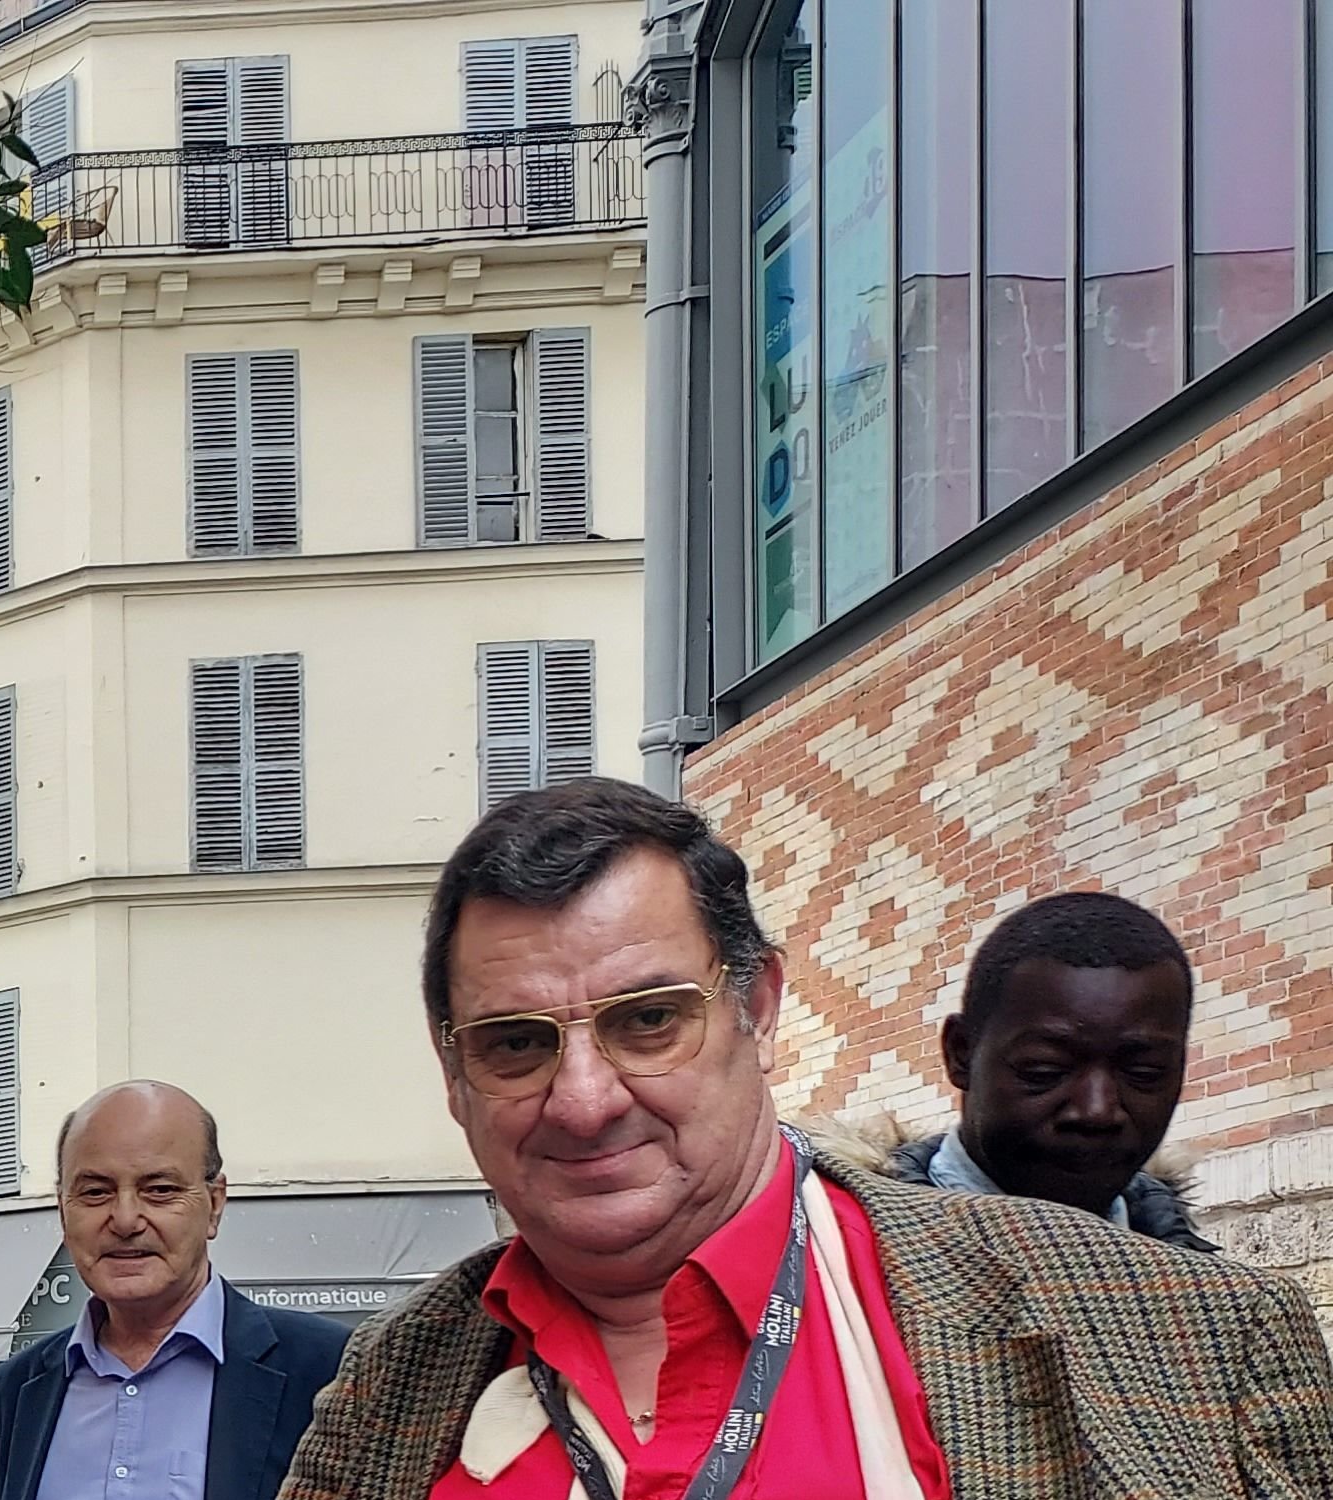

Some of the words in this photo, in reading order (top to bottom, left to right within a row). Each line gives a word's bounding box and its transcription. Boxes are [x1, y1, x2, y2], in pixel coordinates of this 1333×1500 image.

[249, 1287, 387, 1307] Informatique
[764, 1293, 785, 1348] MOLINI
[780, 1302, 792, 1345] ITALIANI
[722, 1408, 746, 1454] MOLINI
[737, 1412, 754, 1451] ITALIANI
